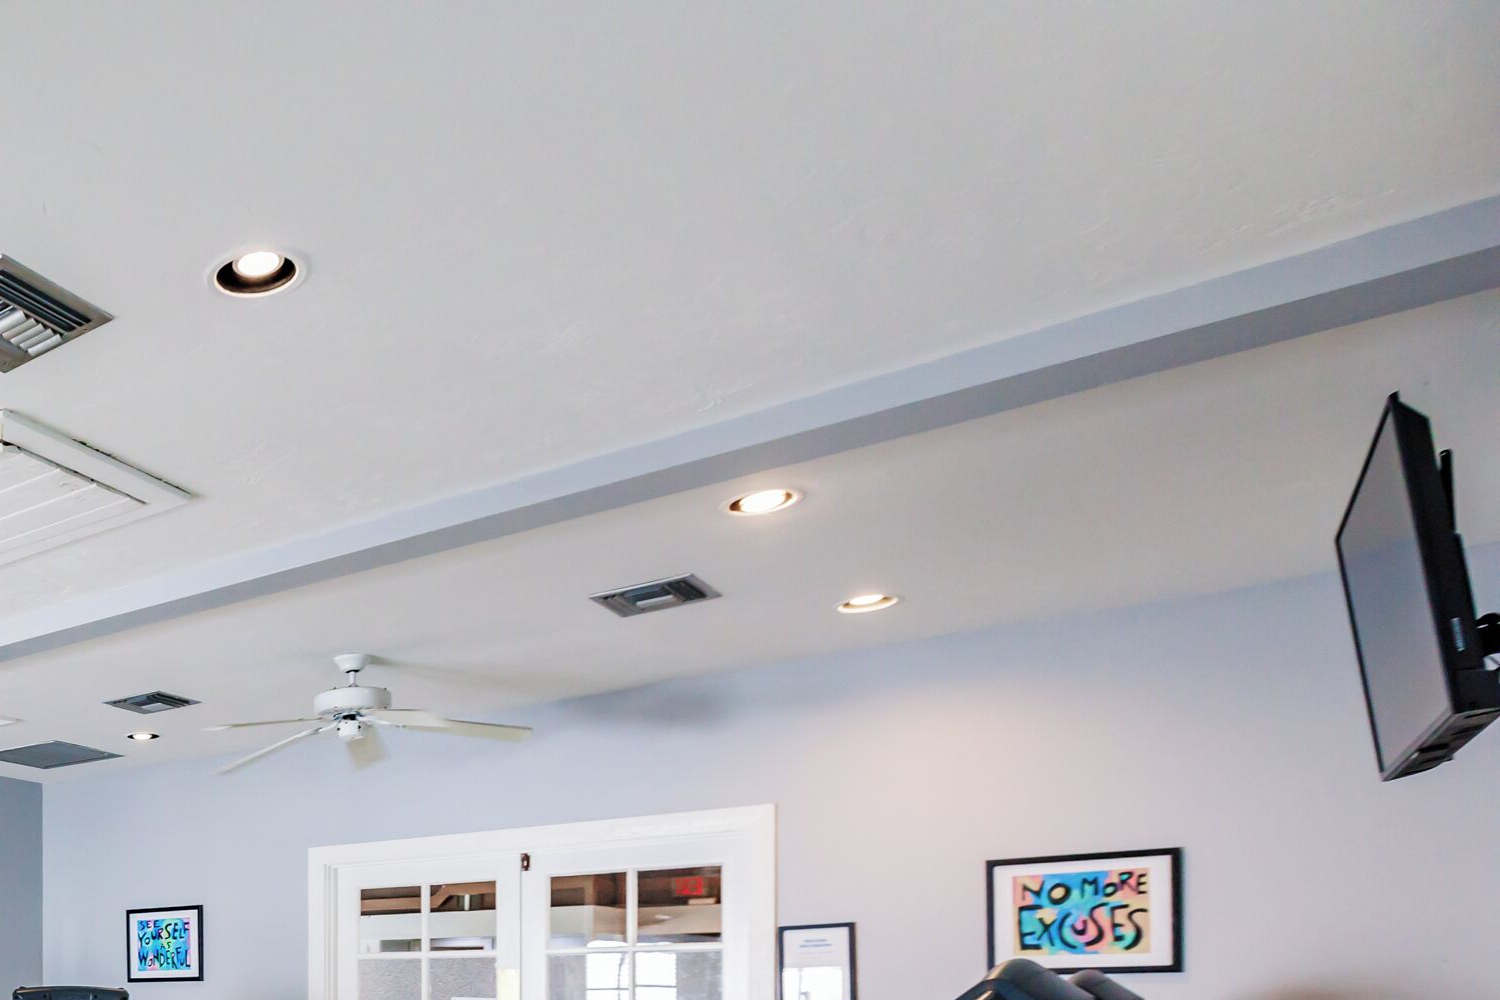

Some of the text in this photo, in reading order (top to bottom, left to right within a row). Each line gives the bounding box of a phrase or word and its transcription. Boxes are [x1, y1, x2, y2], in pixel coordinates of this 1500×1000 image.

[1021, 871, 1148, 905] NO MORE
[138, 921, 190, 948] YOURSELF
[139, 920, 161, 930] SEE
[1018, 902, 1148, 950] EXCUSES
[138, 946, 191, 970] WONDERFUL
